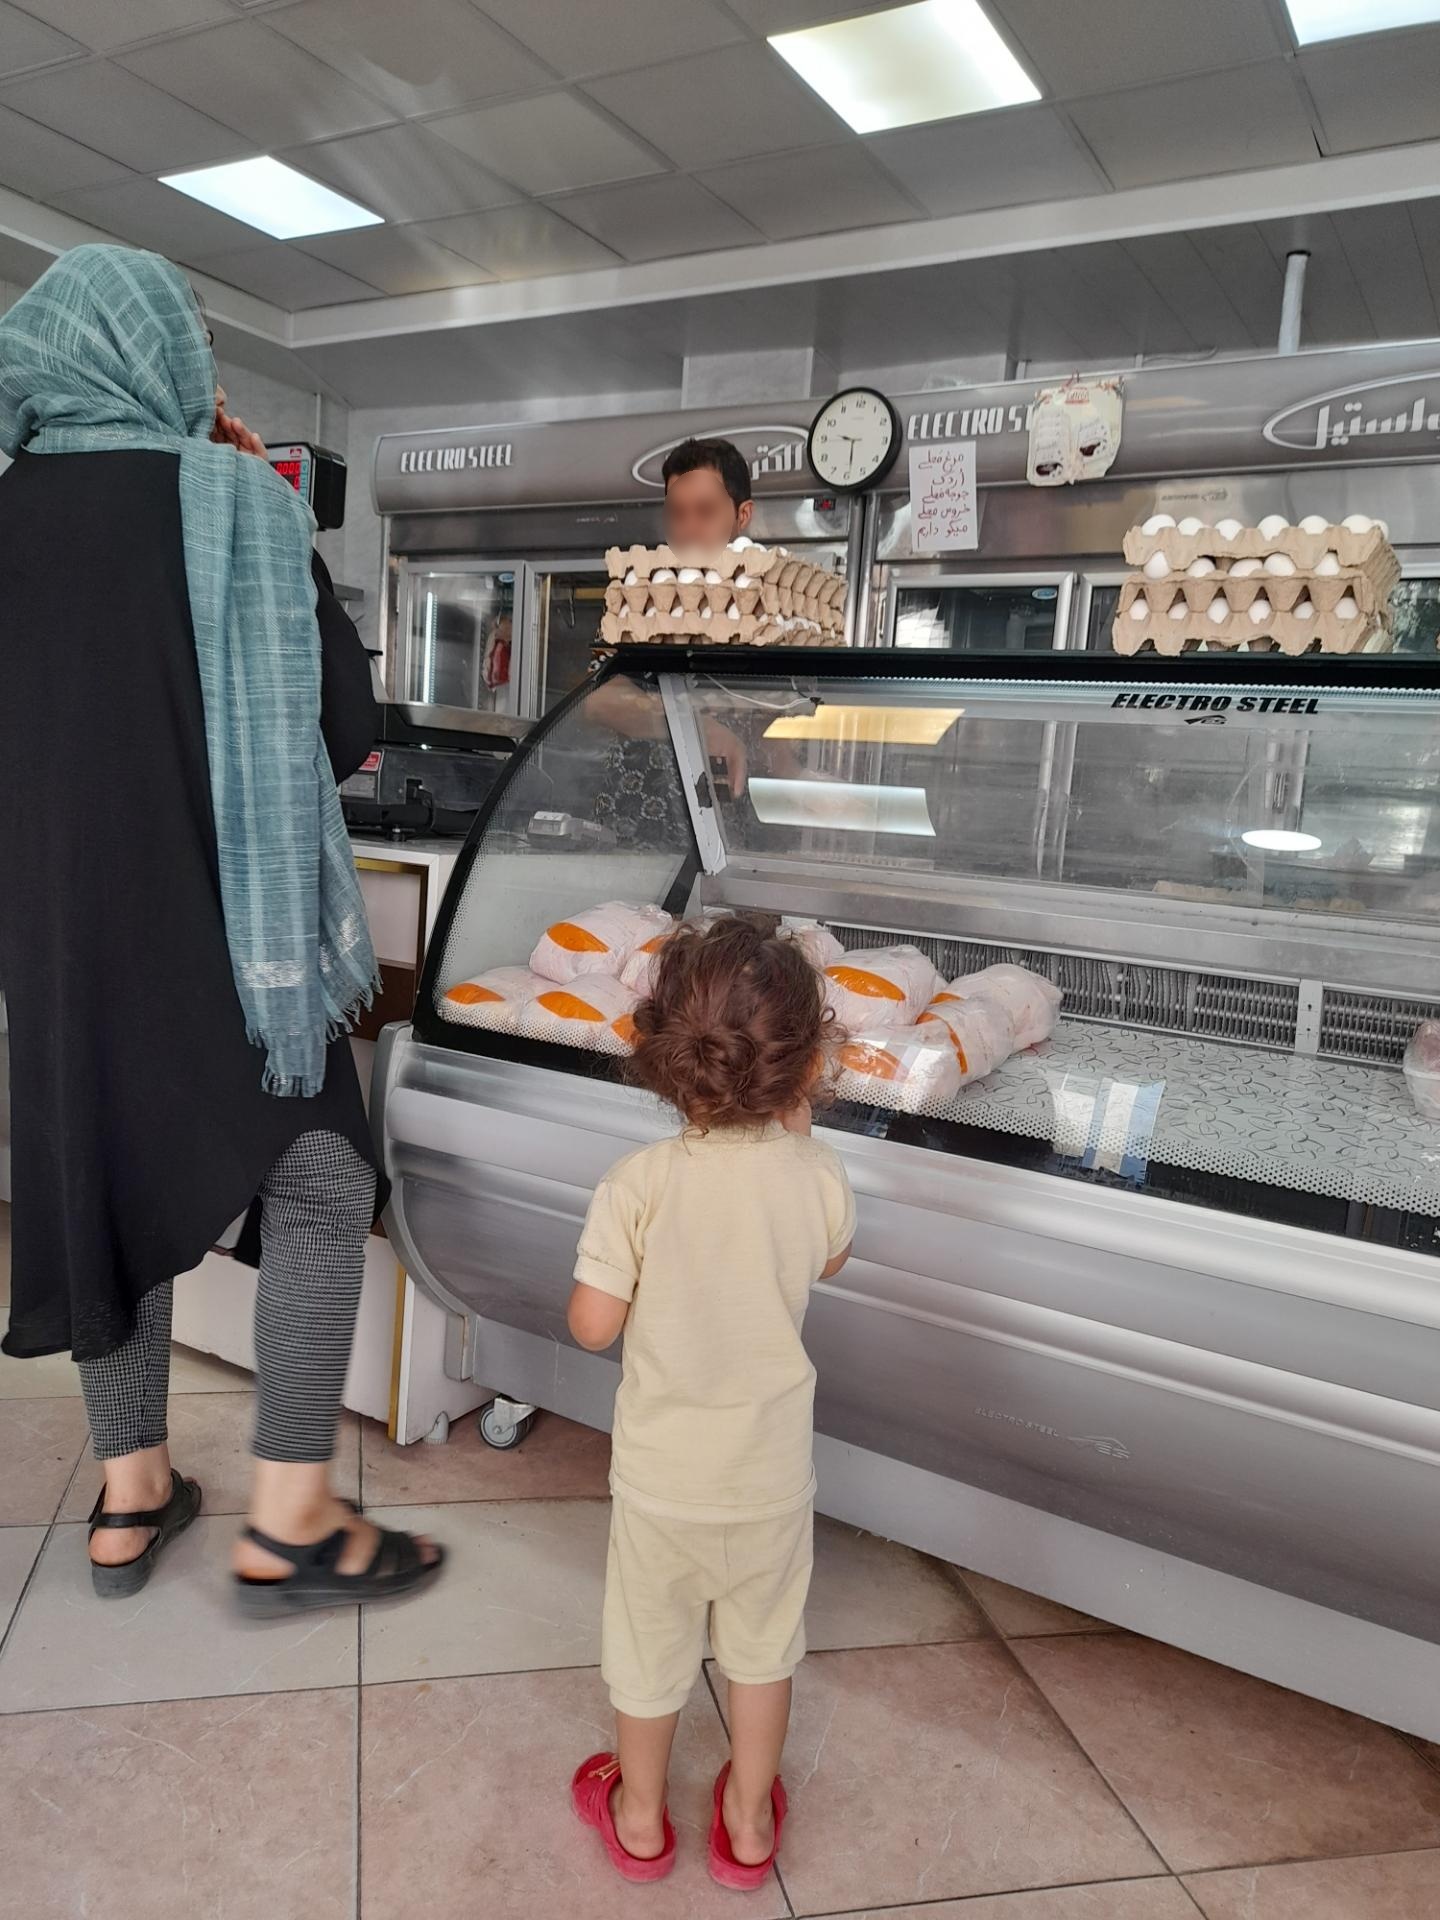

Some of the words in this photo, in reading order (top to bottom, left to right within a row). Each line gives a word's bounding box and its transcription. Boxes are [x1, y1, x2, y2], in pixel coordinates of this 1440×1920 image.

[907, 407, 1004, 440] ELECTRO
[400, 447, 466, 473] ELECTRO
[468, 443, 513, 468] STEEL
[1111, 693, 1232, 711] ELECTRO
[1236, 696, 1319, 715] STEEL
